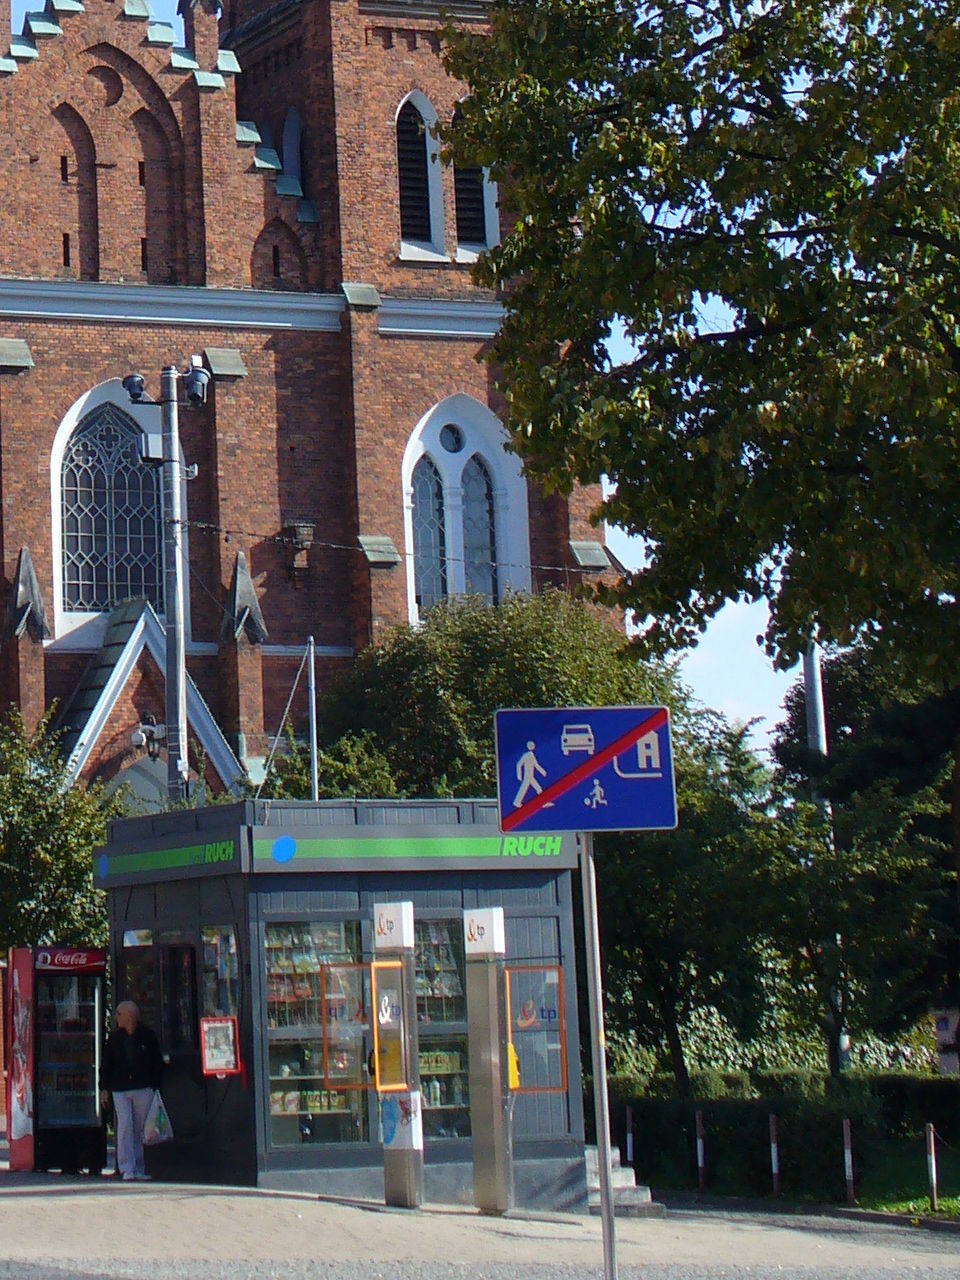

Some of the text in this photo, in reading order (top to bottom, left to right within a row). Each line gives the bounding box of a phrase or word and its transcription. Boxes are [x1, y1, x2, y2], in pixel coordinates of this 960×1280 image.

[205, 840, 234, 863] RUCH
[503, 836, 562, 856] RUCH
[540, 1006, 557, 1024] tp
